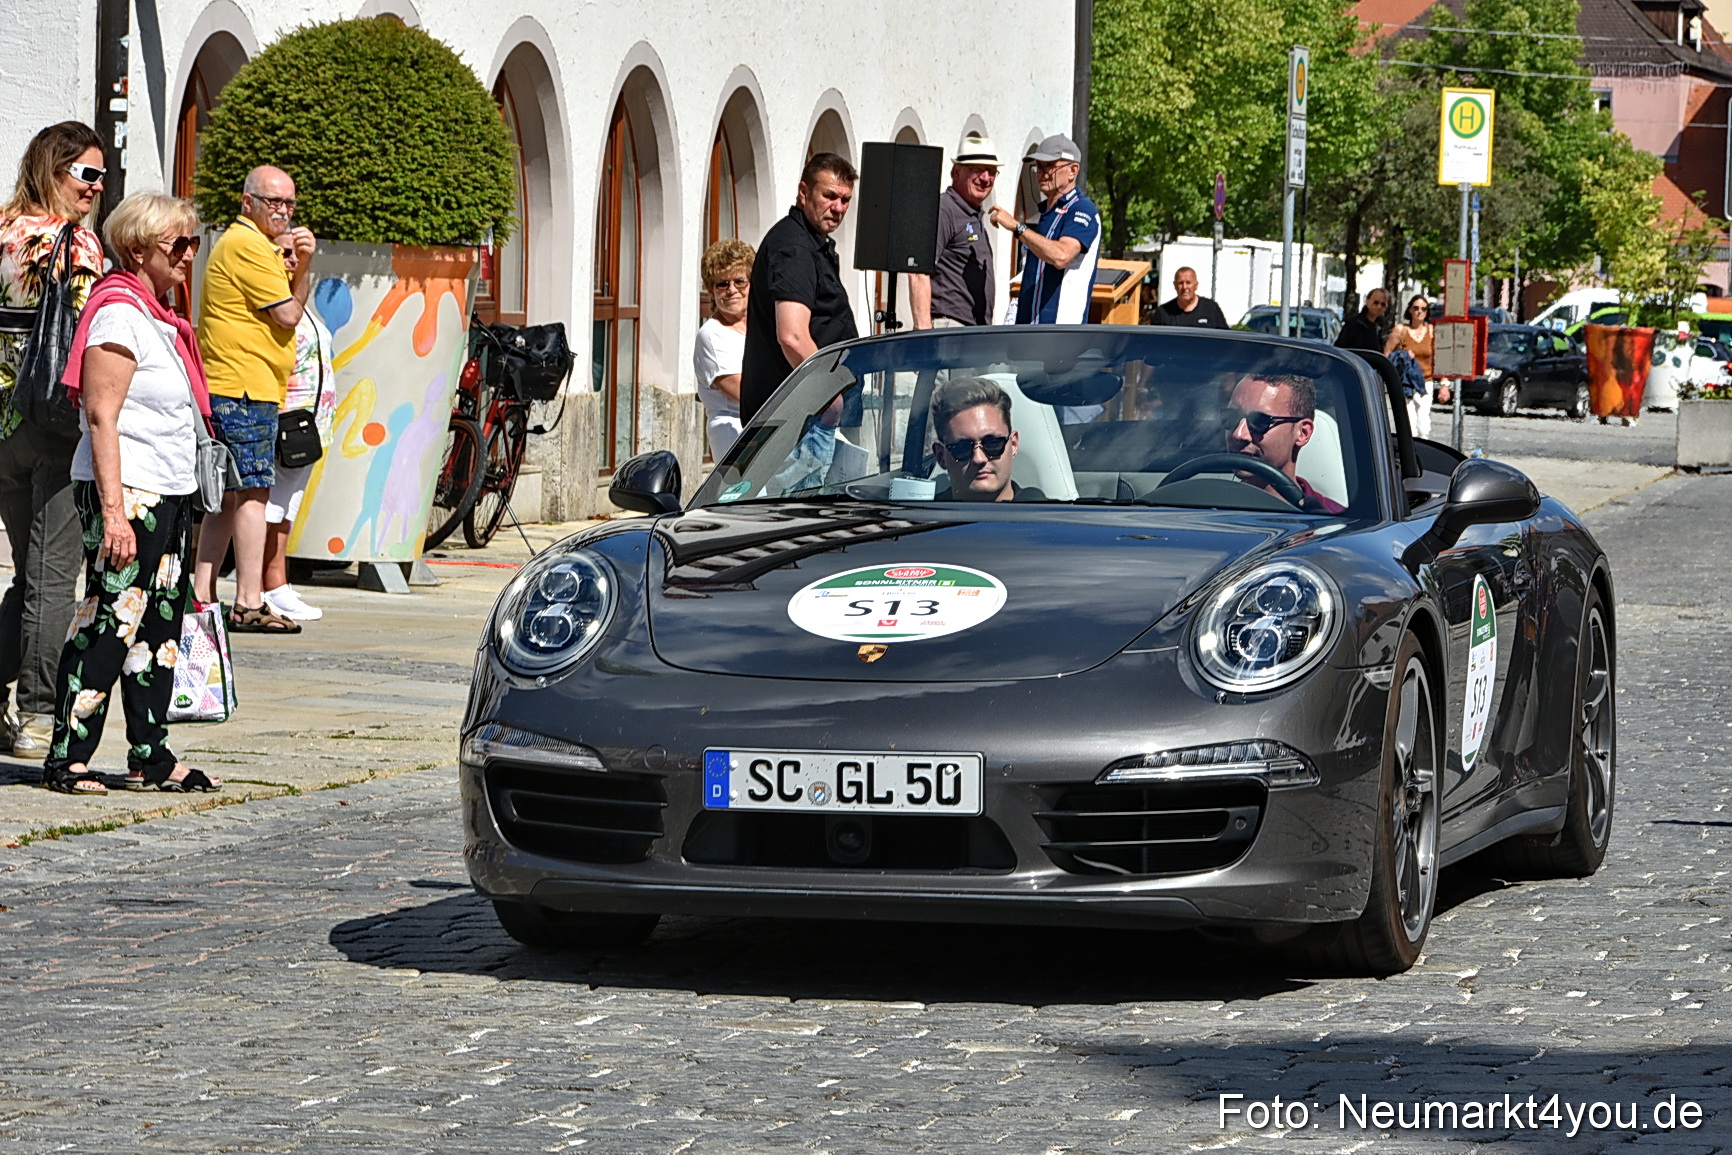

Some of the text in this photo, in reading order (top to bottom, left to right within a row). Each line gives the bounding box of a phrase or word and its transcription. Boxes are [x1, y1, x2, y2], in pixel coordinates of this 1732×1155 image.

[1460, 106, 1474, 129] H
[843, 599, 941, 617] S13
[1471, 675, 1487, 718] S13
[712, 784, 723, 798] D
[747, 759, 962, 806] SC GL 50
